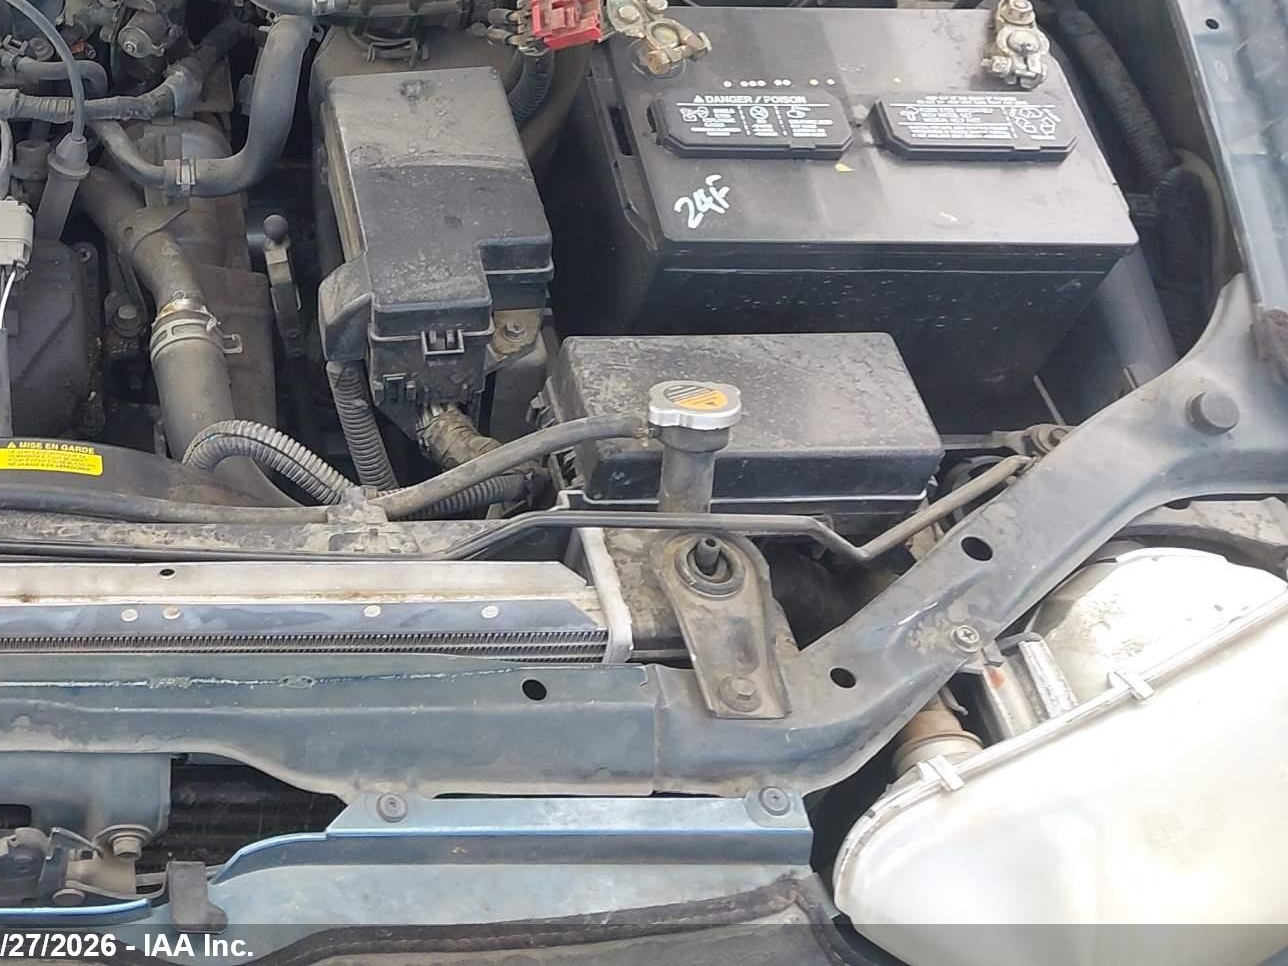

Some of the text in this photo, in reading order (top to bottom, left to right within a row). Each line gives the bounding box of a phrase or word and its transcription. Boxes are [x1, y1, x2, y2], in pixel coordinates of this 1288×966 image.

[705, 95, 752, 104] DANGER
[764, 95, 807, 104] POISON
[18, 441, 95, 454] MISE EN GARDE
